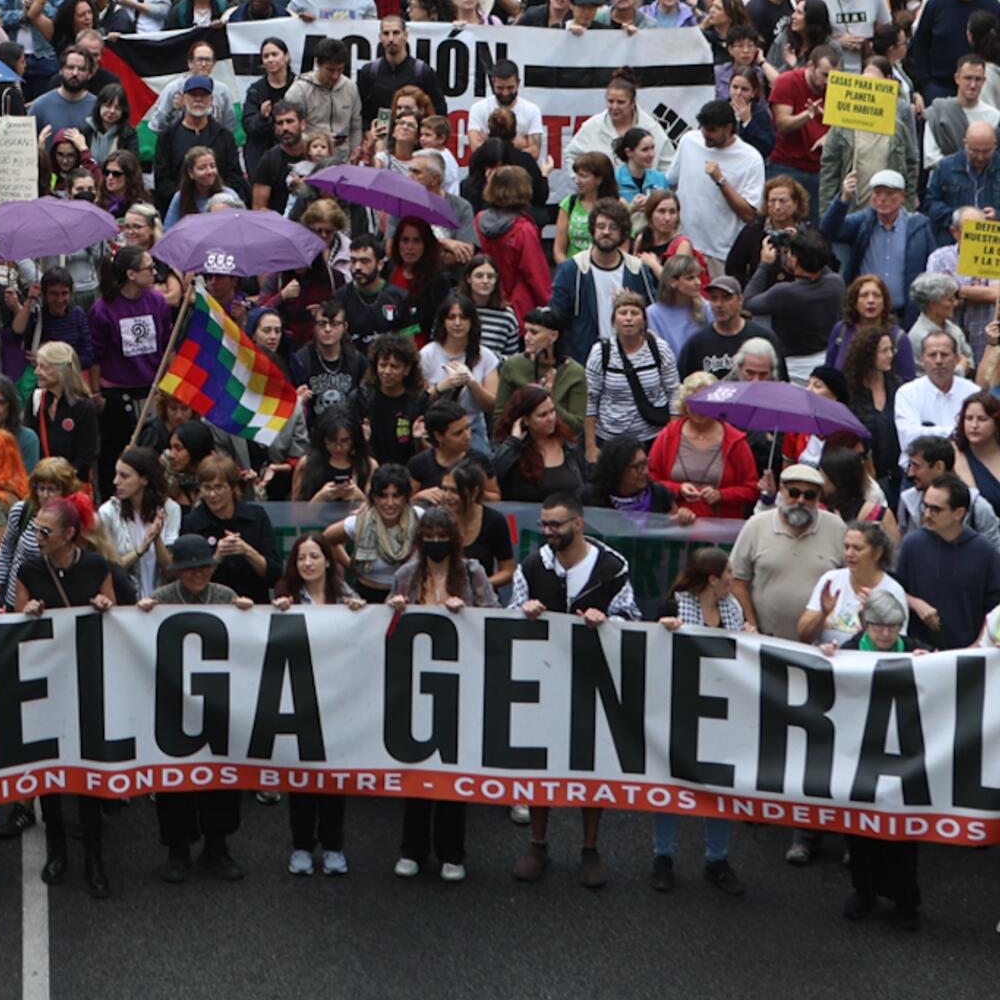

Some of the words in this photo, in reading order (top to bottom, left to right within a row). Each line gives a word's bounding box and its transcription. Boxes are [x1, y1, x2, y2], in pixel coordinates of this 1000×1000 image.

[301, 28, 508, 98] ACIÓN
[831, 74, 853, 88] CASAS
[854, 79, 873, 91] PARA
[845, 89, 876, 104] PLANETA
[837, 100, 851, 113] QUE
[853, 104, 884, 117] HABITAR
[974, 255, 979, 264] Y
[981, 256, 992, 265] LA
[383, 611, 1000, 811] GENERAL
[87, 767, 239, 794] FONDOS
[259, 769, 403, 792] BUITRE
[454, 776, 697, 810] CONTRATOS
[717, 796, 987, 841] INDEFINIDOS
